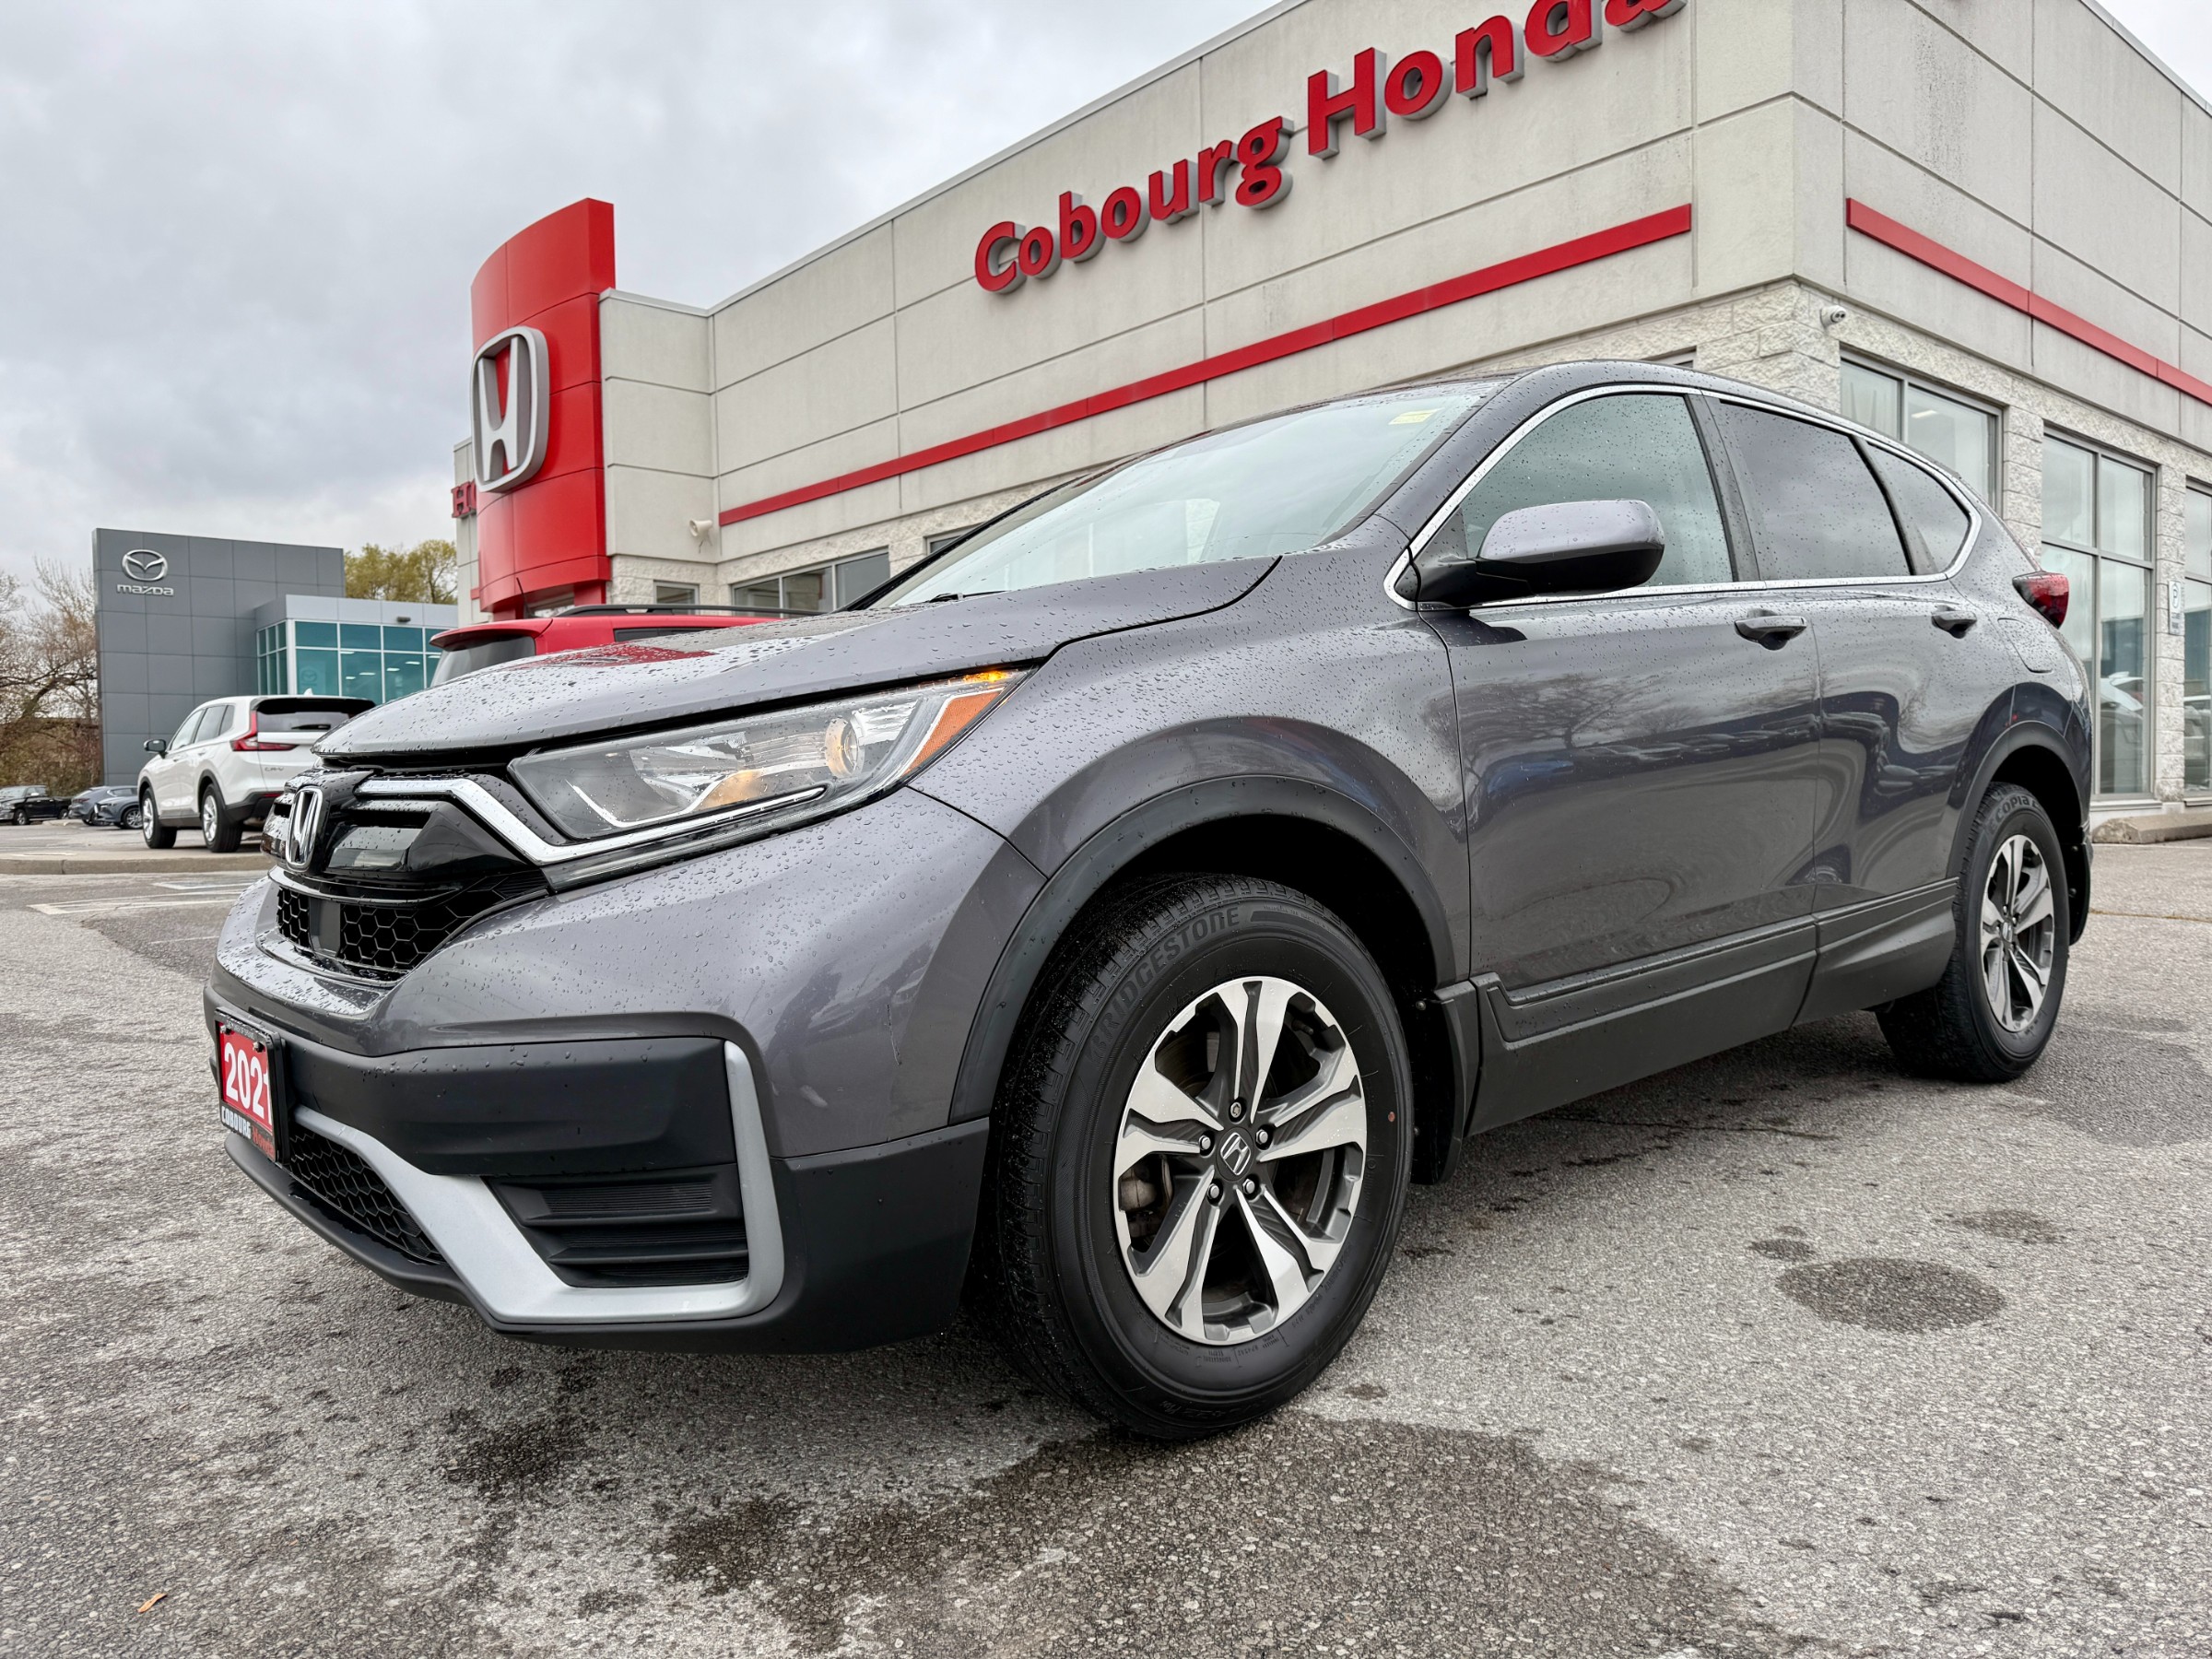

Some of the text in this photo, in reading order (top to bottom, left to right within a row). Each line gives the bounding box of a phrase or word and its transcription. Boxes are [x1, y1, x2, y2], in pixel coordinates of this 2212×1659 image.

[974, 115, 1292, 297] Cobourg
[116, 583, 174, 597] mazda
[1088, 906, 1241, 1062] BRIDGESTONE
